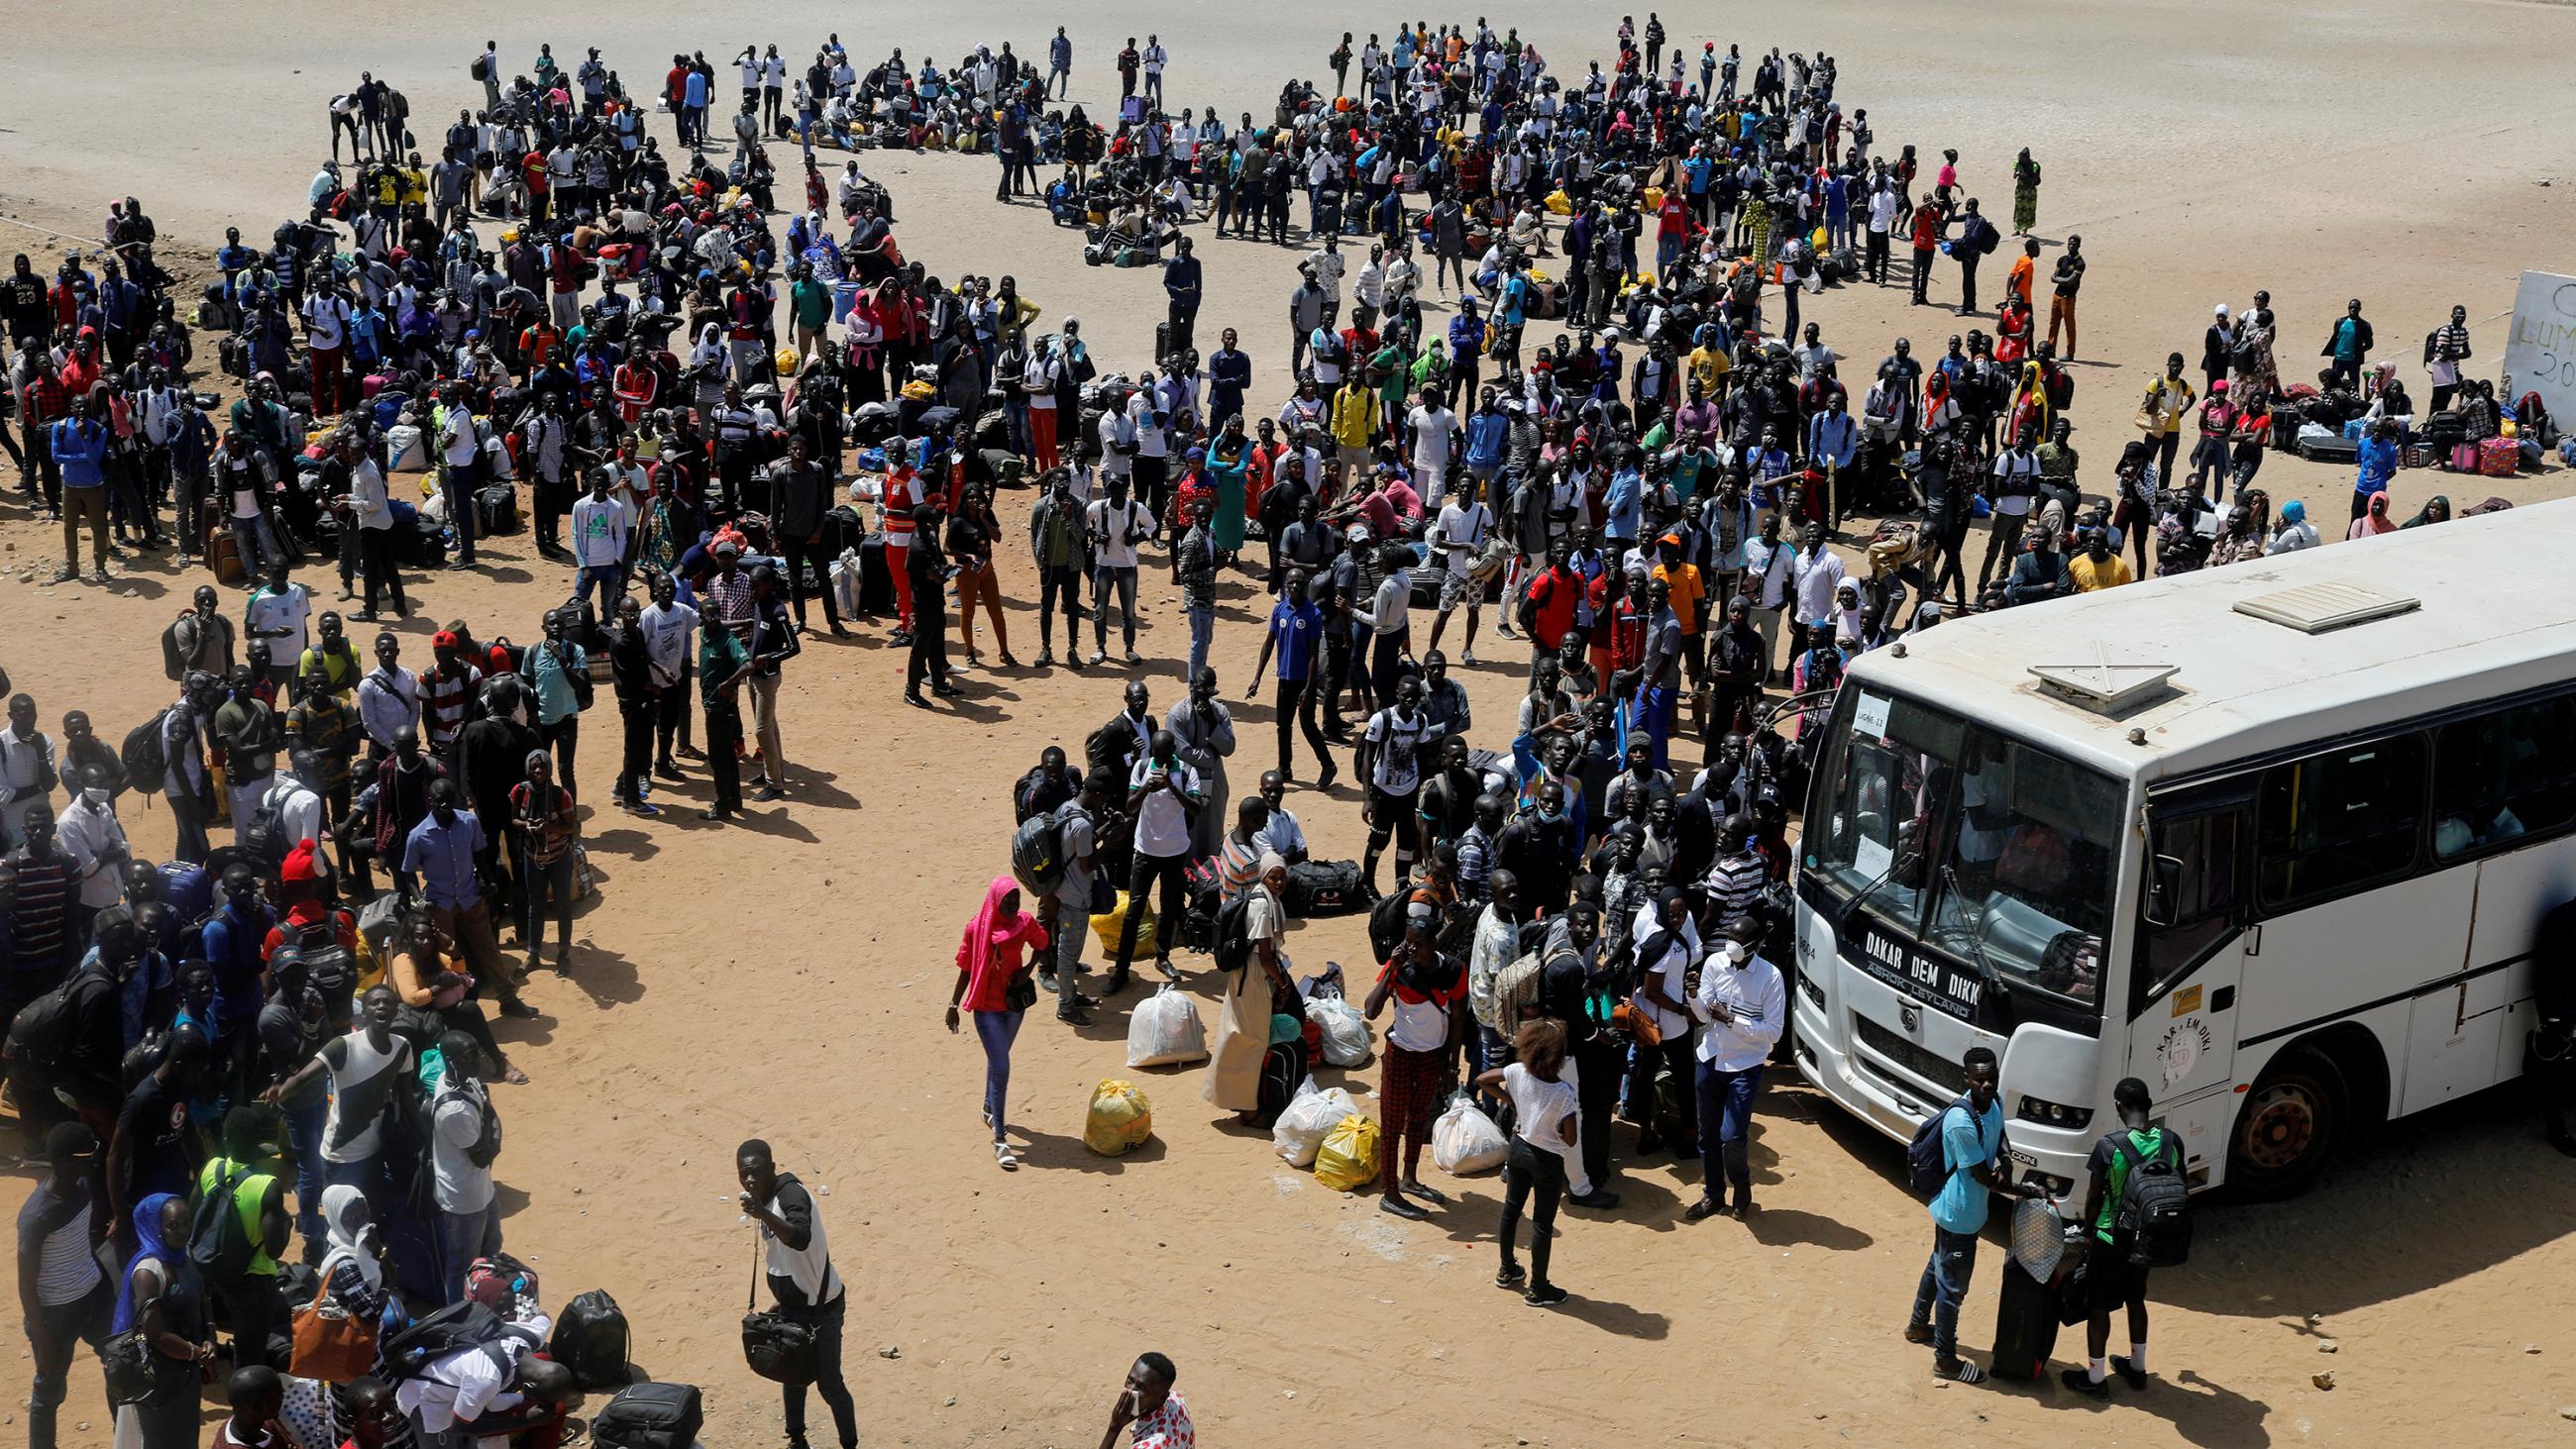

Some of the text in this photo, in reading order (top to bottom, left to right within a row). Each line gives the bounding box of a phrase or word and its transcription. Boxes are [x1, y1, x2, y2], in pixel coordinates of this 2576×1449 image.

[1866, 931, 1980, 1005] DAKAR DEM DIKK
[1867, 961, 1970, 1018] ASHOK LEYLAND
[2011, 1151, 2036, 1166] CON
